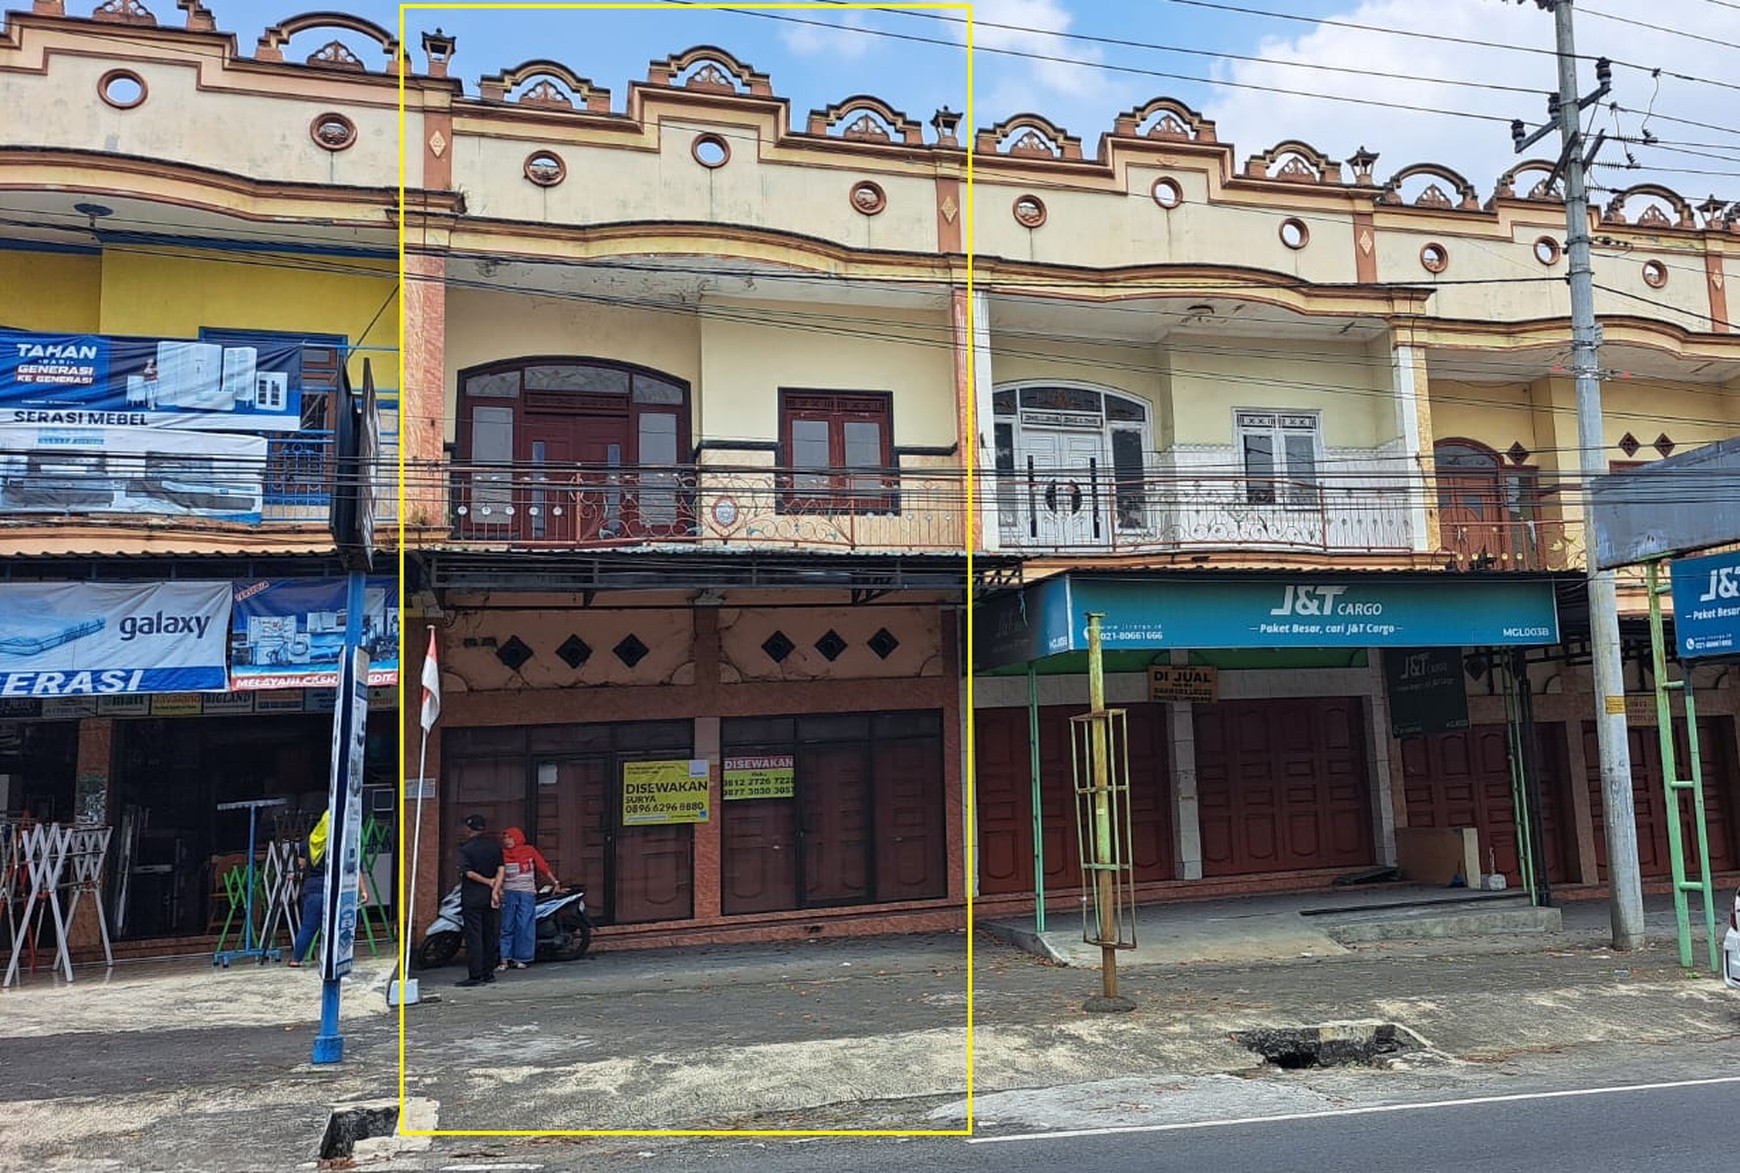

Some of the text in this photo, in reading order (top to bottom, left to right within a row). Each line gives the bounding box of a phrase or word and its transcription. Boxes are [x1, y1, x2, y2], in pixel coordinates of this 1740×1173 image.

[16, 343, 97, 359] TAHAN
[17, 364, 94, 376] GENERASI
[16, 374, 93, 385] KE GENERASI
[14, 410, 148, 425] SERASI MEBEL
[1699, 566, 1740, 602] J&
[1270, 585, 1382, 616] J&T CARGO
[1693, 608, 1717, 621] Paket
[119, 610, 211, 641] galaxy
[1260, 623, 1395, 635] Paket Besar, cari J&T Cargo
[0, 669, 144, 696] ERASI
[236, 676, 300, 689] MELAYANI
[1154, 671, 1212, 683] DI JUAL
[723, 758, 794, 774] DISEWAKAN
[625, 781, 708, 795] DISEWAKAN
[625, 795, 657, 804] SURYA
[625, 803, 651, 814] 0896
[653, 802, 678, 813] 6296
